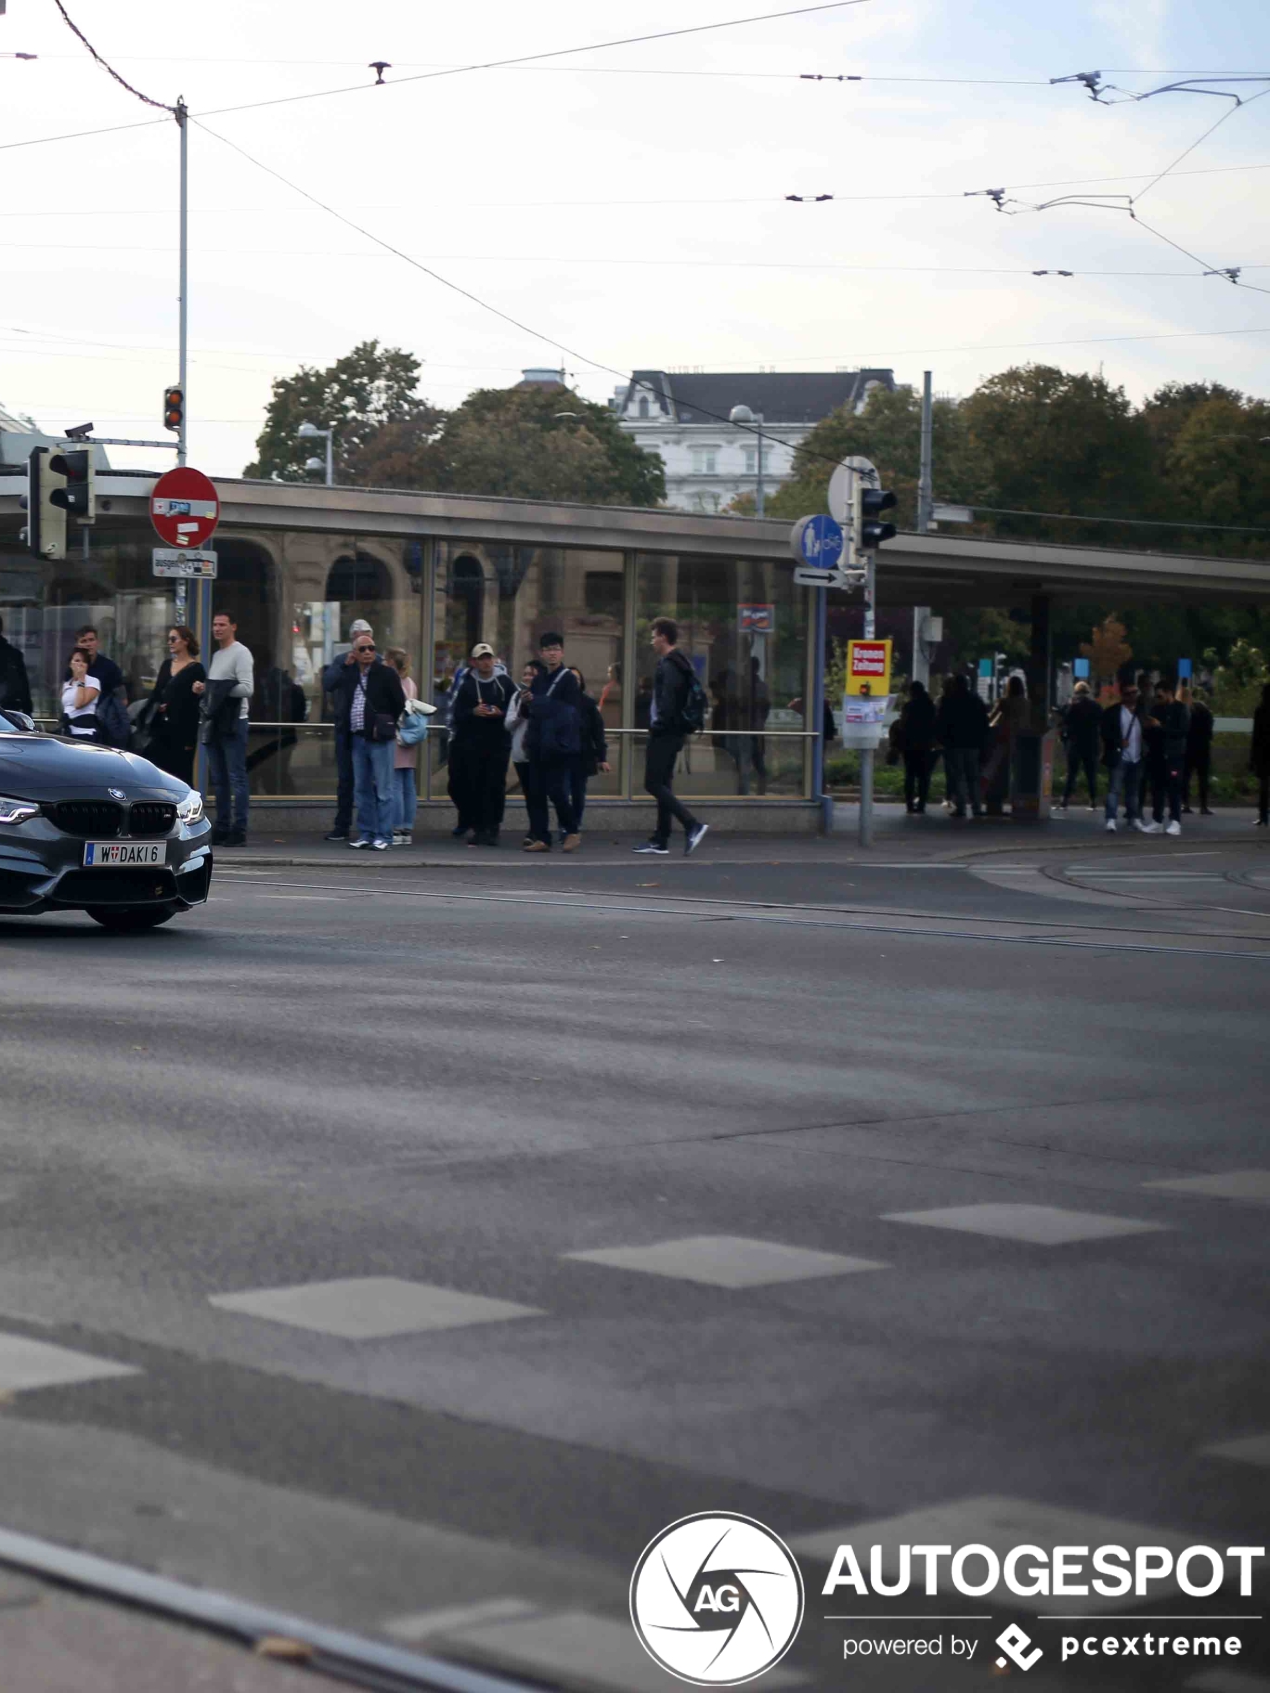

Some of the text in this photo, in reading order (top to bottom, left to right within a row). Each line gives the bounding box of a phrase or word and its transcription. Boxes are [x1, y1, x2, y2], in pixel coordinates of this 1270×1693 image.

[853, 648, 885, 659] Kronen
[853, 660, 885, 673] Zeitung
[101, 846, 111, 862] W
